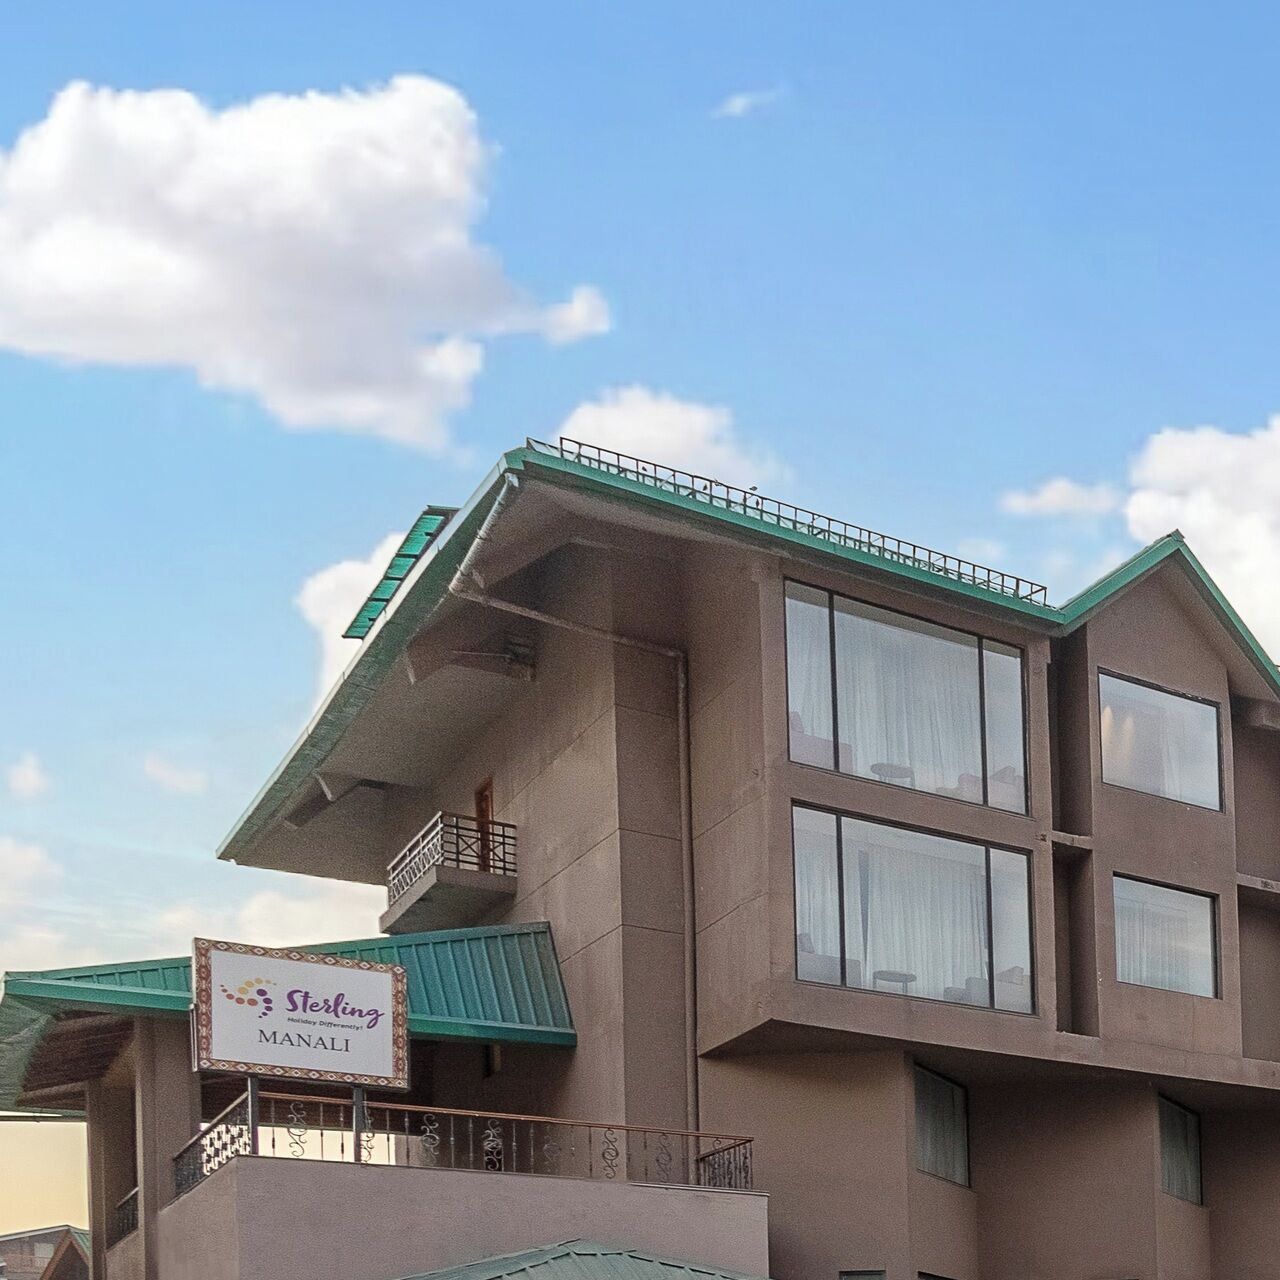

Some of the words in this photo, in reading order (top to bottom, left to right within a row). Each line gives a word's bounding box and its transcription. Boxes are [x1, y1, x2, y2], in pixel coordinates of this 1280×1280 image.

[285, 989, 385, 1030] Sterling
[287, 1016, 317, 1026] Holiday
[258, 1029, 351, 1053] MANALI
